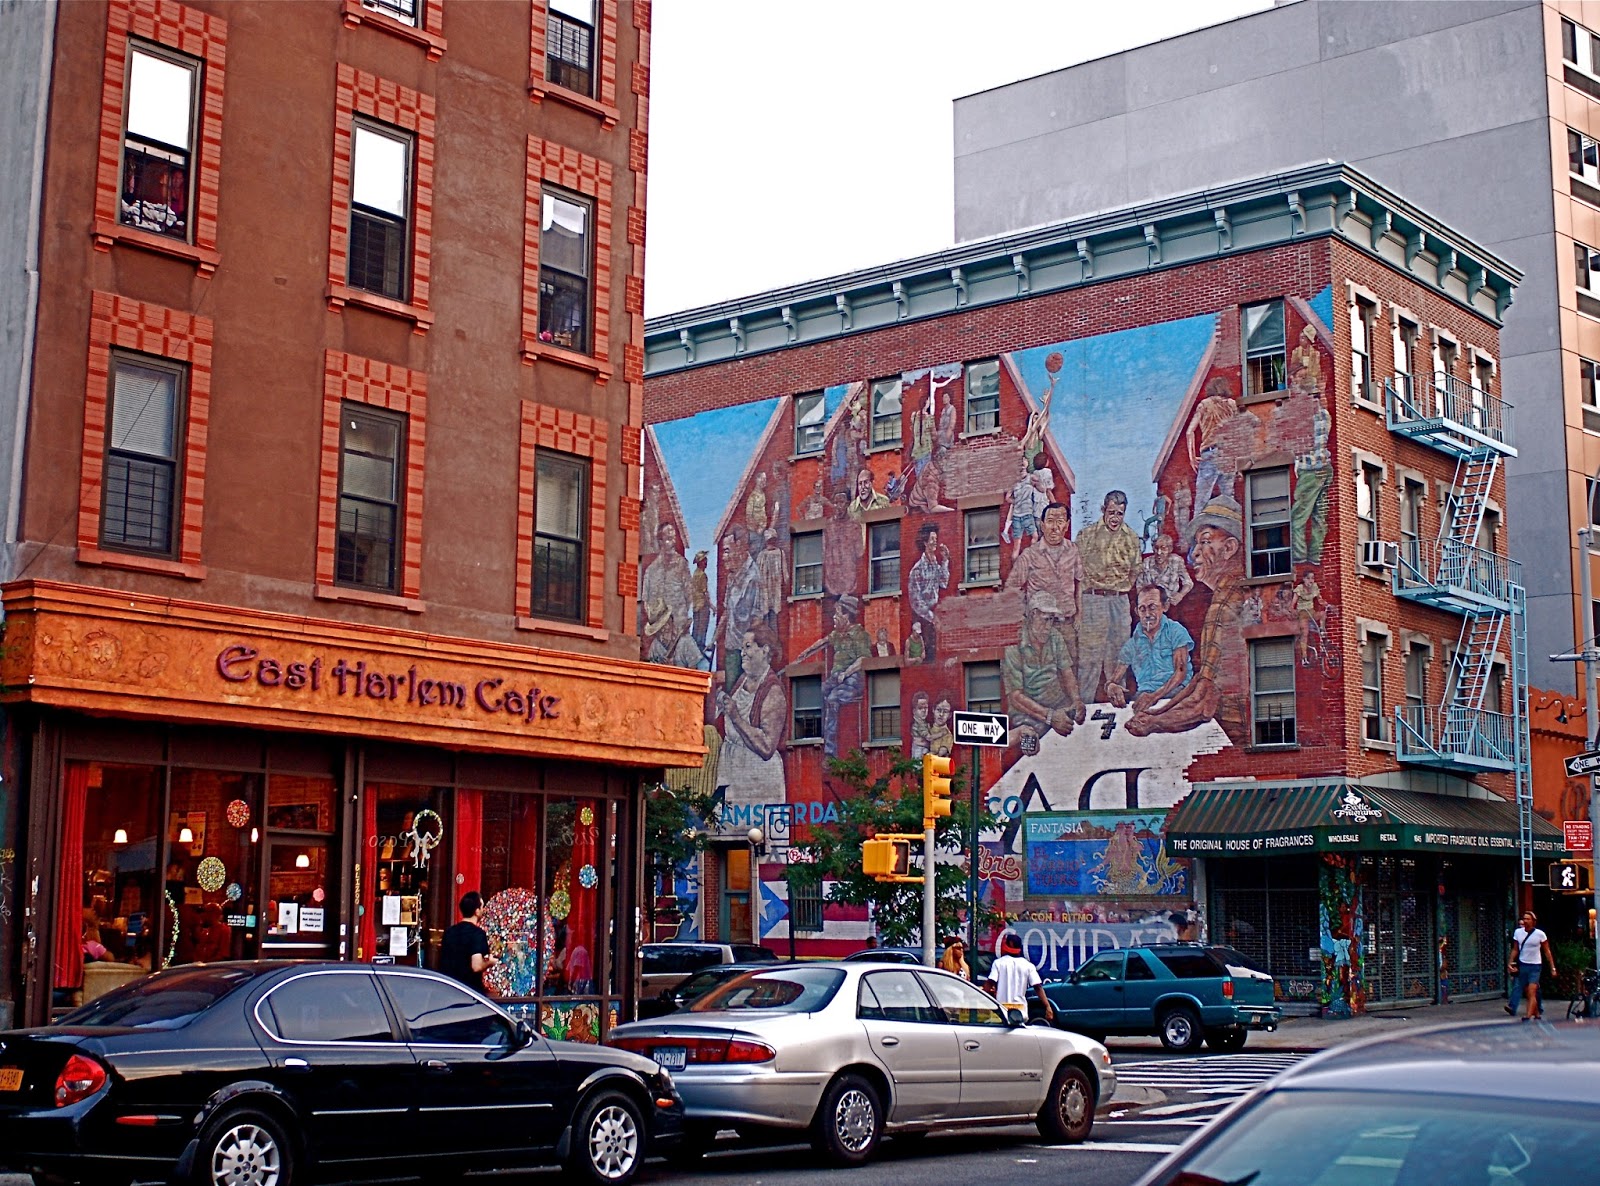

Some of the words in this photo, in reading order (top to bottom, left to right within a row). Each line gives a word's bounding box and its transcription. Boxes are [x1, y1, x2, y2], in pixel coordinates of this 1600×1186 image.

[217, 644, 321, 691] East
[332, 658, 467, 709] Harlem
[474, 678, 562, 723] Cafe
[962, 722, 978, 735] ONE
[984, 724, 1000, 736] WAY
[1573, 759, 1590, 770] ONE
[720, 801, 853, 826] AMSTERDA
[1031, 821, 1083, 834] FANTASIA
[1173, 839, 1188, 850] THE
[1189, 839, 1223, 850] ORIGINAL
[1225, 839, 1250, 850] HOUSE
[1252, 838, 1264, 849] OF
[1265, 834, 1314, 848] FRAGRANCES
[1328, 834, 1359, 843] WHOLESALE
[1380, 833, 1397, 842] RETAIL
[1425, 833, 1448, 845] IMPORTED
[1450, 835, 1477, 847] FRAGRANCE
[1533, 841, 1553, 851] DESIGNER
[1033, 846, 1050, 858] EL
[1031, 858, 1079, 871] BARRIO
[1034, 872, 1078, 886] TOURS
[1031, 912, 1053, 922] CON
[1062, 912, 1094, 923] RITMO
